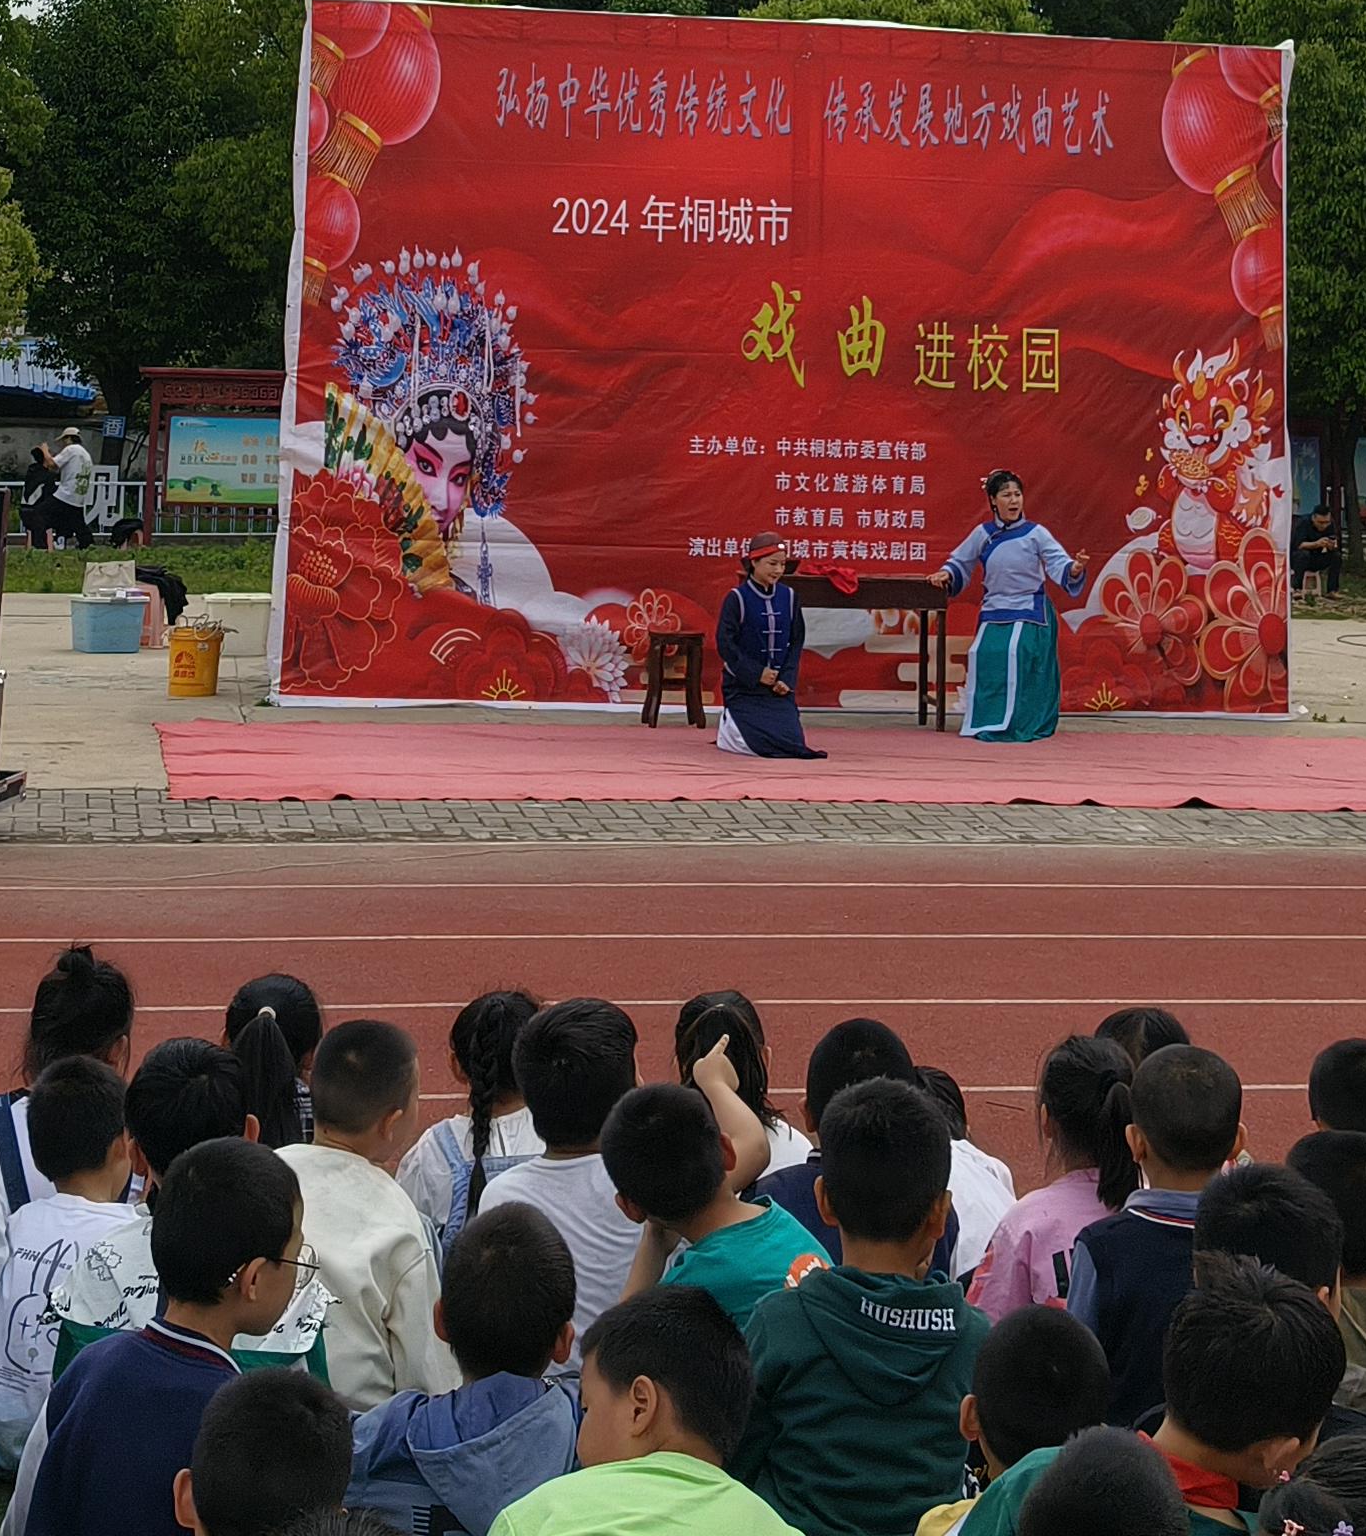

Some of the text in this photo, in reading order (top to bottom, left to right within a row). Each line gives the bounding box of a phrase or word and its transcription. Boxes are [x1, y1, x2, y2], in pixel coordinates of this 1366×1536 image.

[495, 62, 1115, 156] 弘扬中华优秀传统文化 传承发展地方戏曲艺术
[774, 471, 926, 496] 市文化旅游体育局
[774, 506, 926, 529] 市教育局 市财政局
[860, 1296, 956, 1331] HUSHUSH
